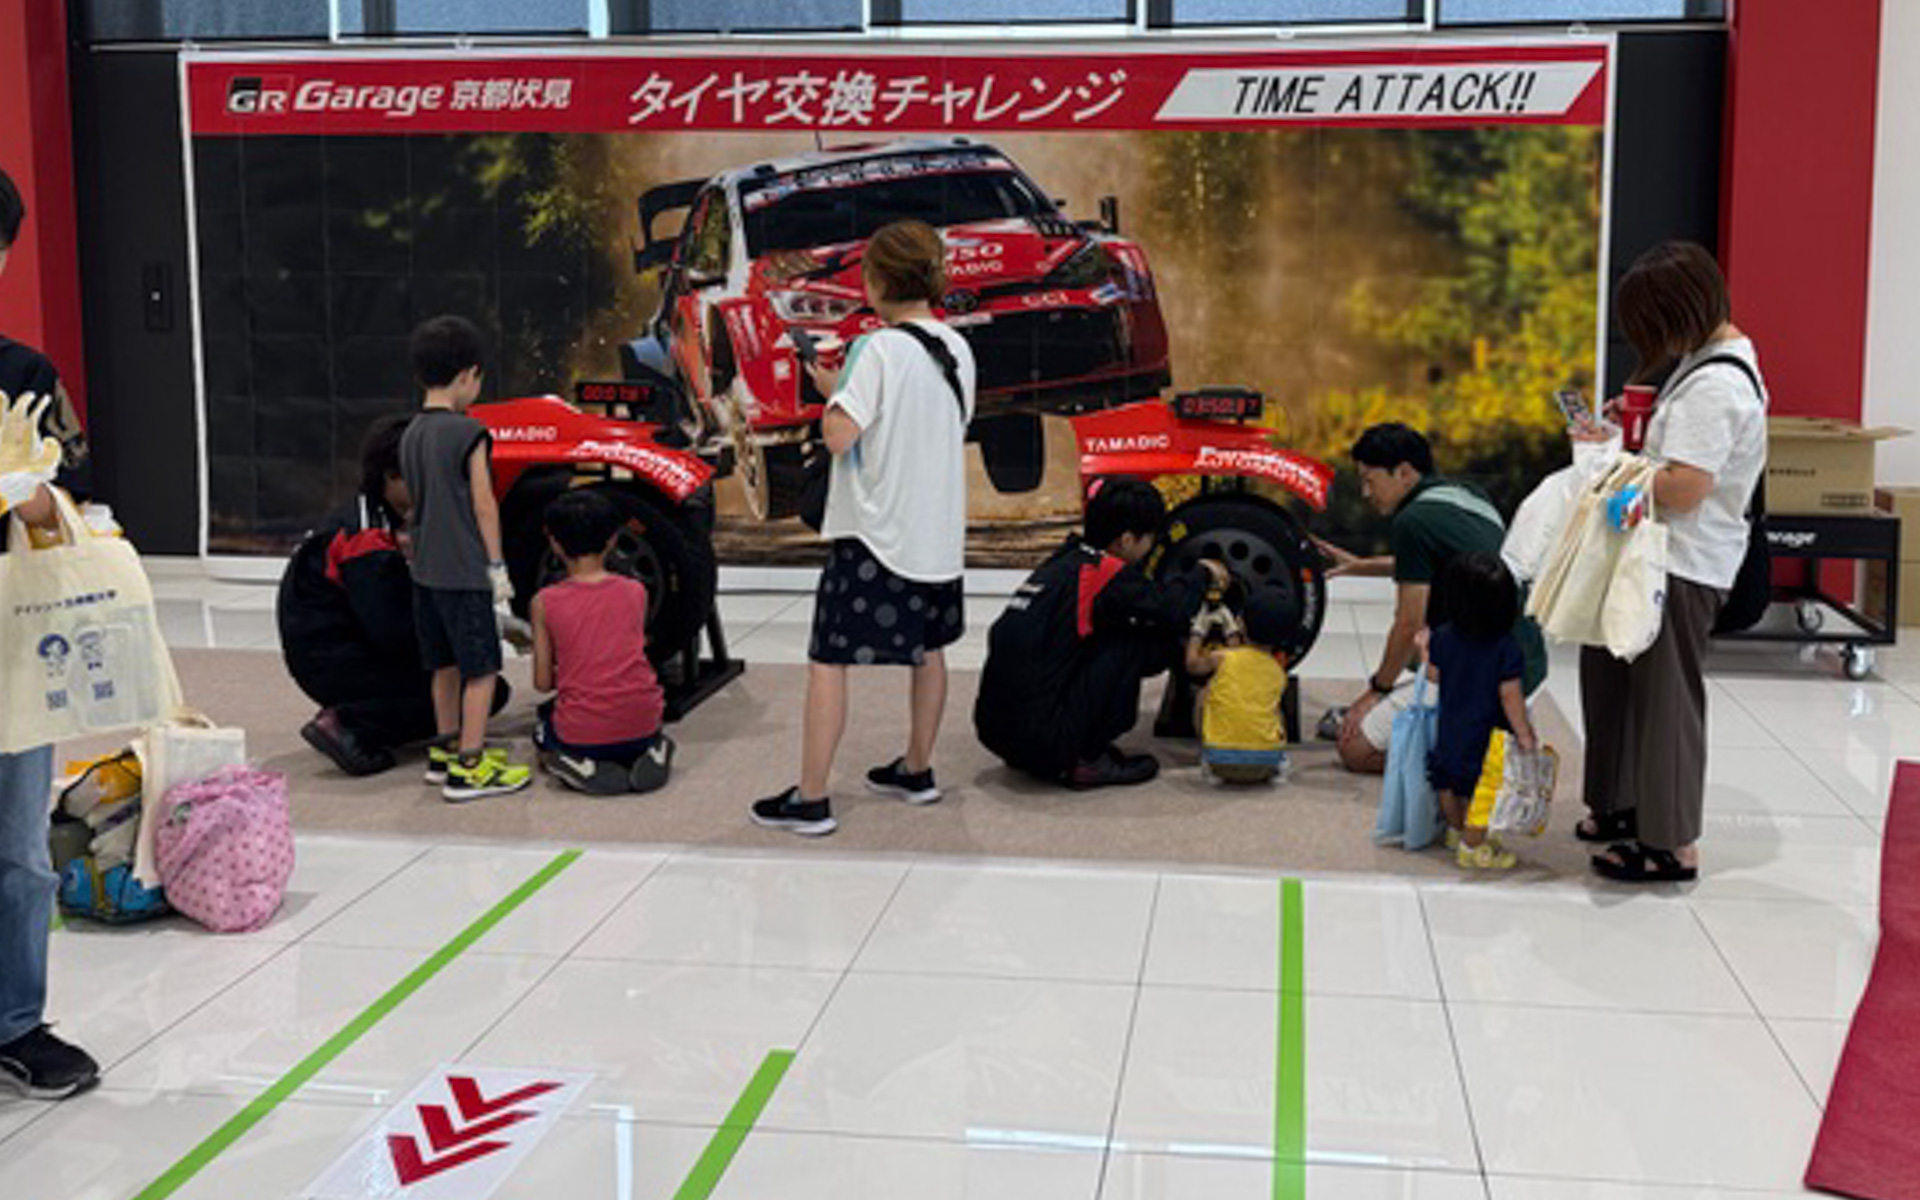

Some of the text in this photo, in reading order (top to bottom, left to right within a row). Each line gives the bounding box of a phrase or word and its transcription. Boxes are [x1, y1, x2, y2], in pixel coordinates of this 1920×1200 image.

[229, 78, 572, 117] GR Garage 京都伏見
[628, 69, 1128, 126] タイヤ交換チャレンジ
[1233, 70, 1537, 115] TIME ATTACK!!
